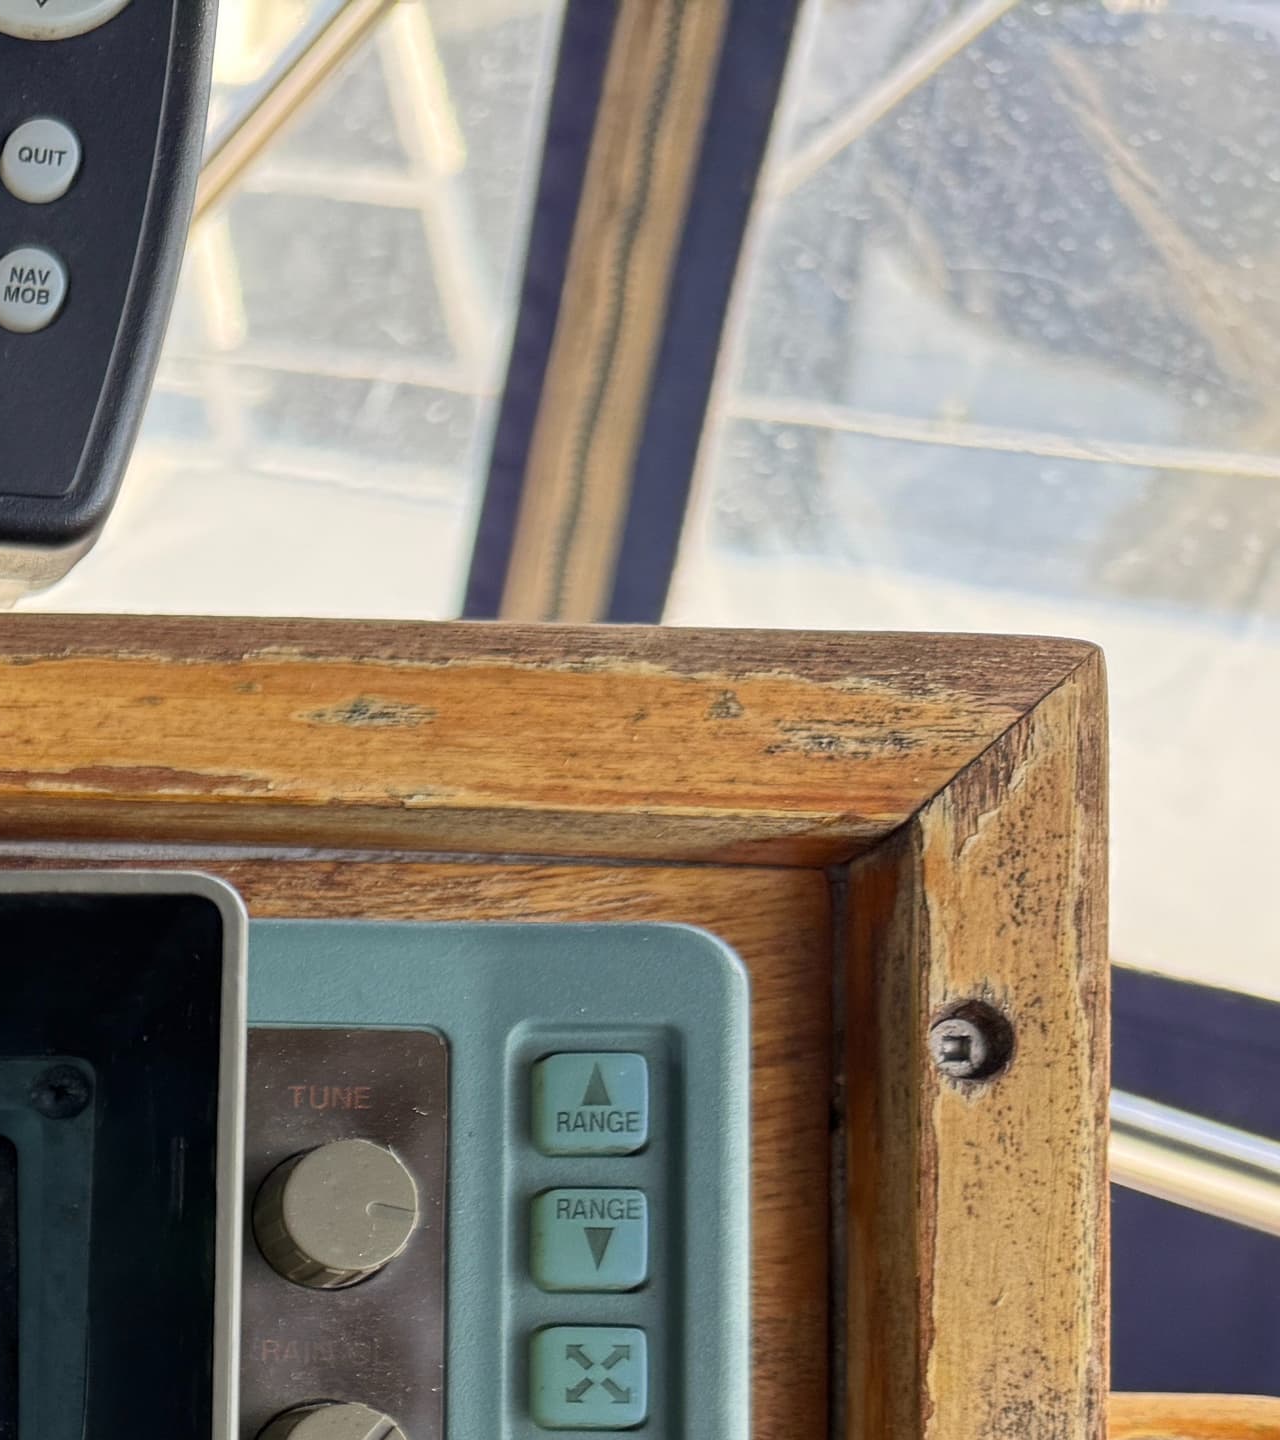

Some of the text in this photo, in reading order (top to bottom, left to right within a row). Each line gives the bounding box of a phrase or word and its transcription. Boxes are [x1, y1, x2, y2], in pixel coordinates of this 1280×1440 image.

[17, 146, 67, 167] QUIT
[9, 266, 51, 285] NAV
[3, 286, 50, 305] MOB
[287, 1084, 373, 1110] TUNE
[556, 1111, 642, 1133] RANGE
[556, 1198, 643, 1221] RANGE
